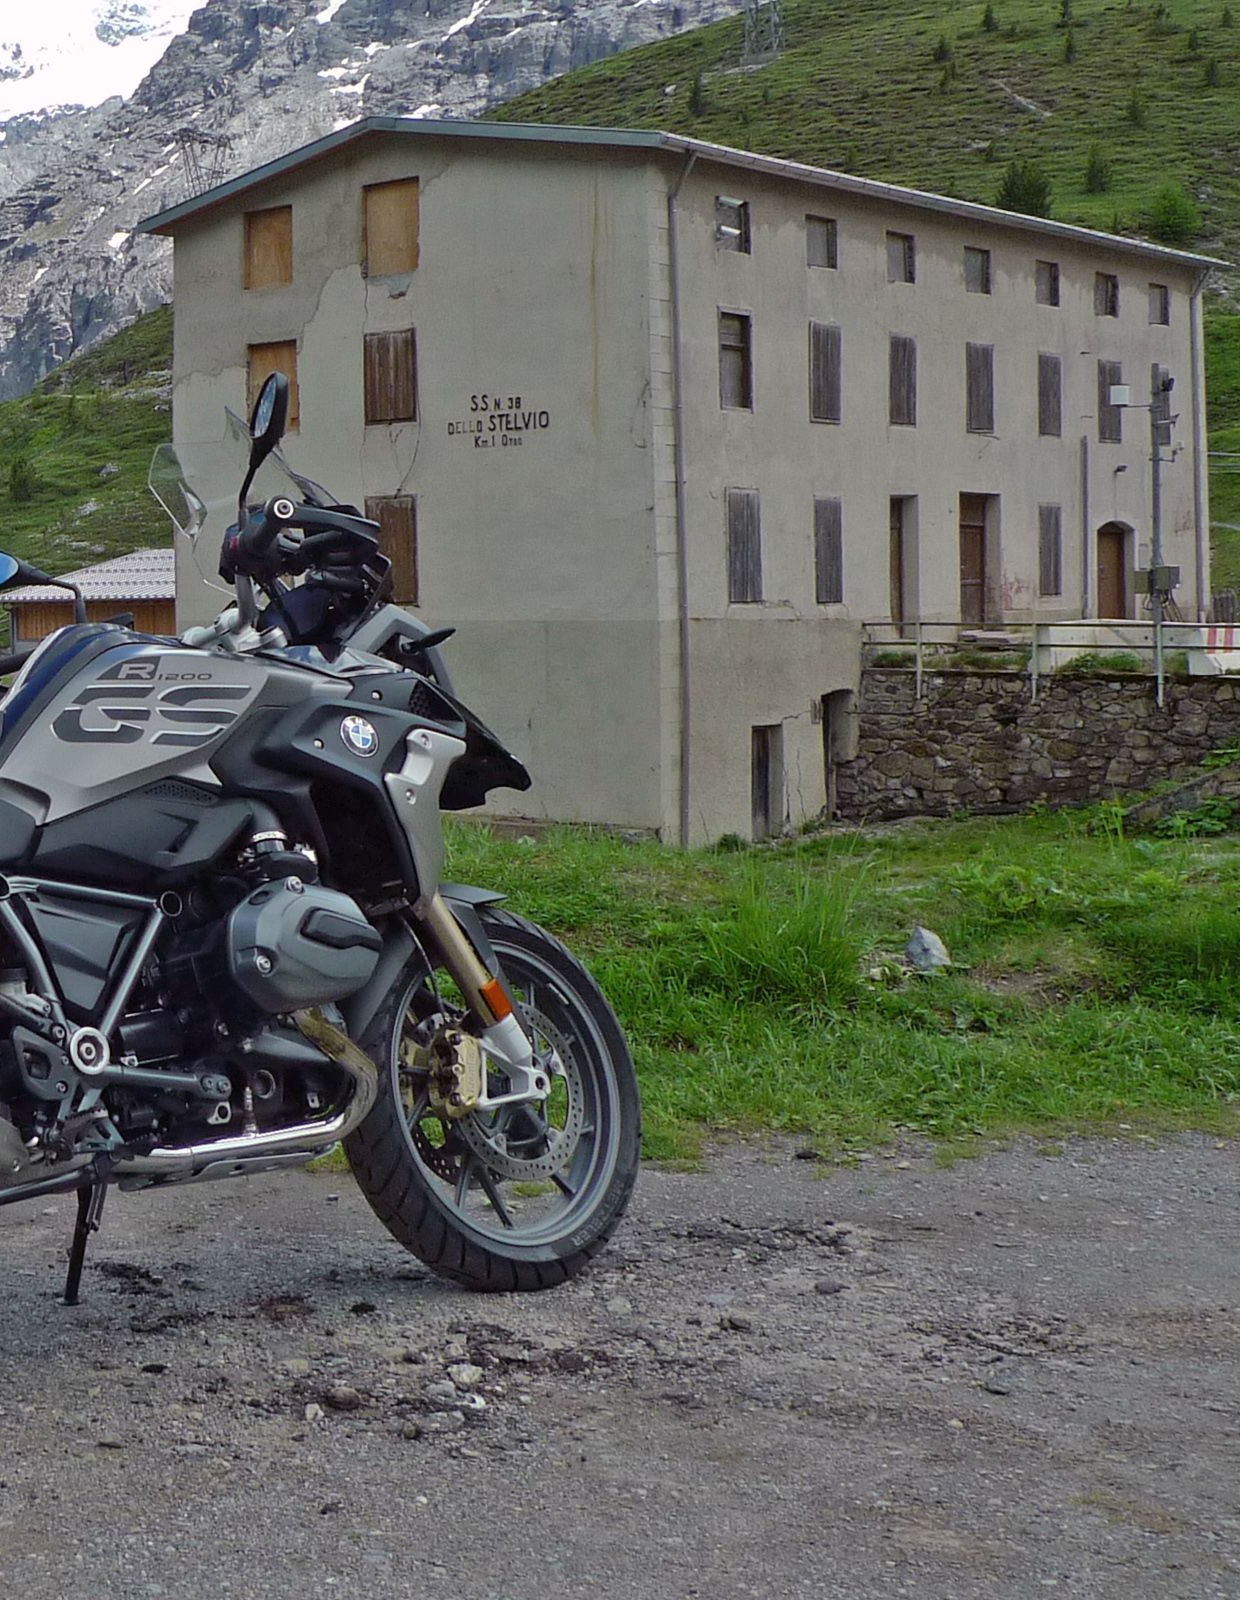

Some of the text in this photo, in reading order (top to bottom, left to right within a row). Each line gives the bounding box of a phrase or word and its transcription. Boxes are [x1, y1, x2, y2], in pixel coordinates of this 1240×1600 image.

[508, 396, 521, 409] 38
[448, 411, 549, 435] DELLO STELVIO
[117, 663, 213, 681] R 1200
[50, 684, 252, 747] GS
